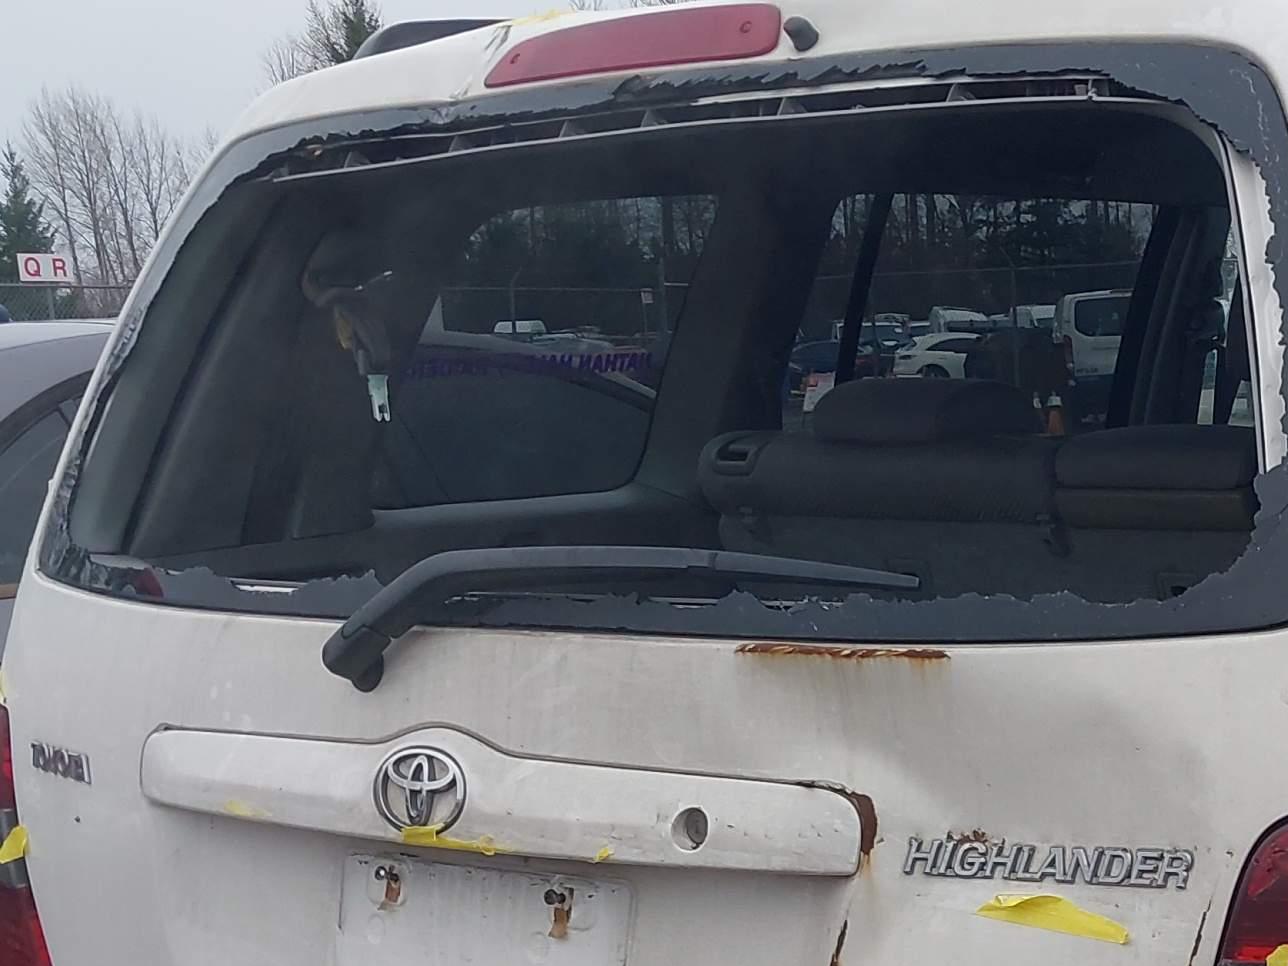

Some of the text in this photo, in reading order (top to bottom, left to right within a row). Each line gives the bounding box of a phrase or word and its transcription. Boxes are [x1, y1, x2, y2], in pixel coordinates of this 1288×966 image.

[24, 257, 68, 277] Q R
[903, 834, 1196, 889] HIGHLANDER
